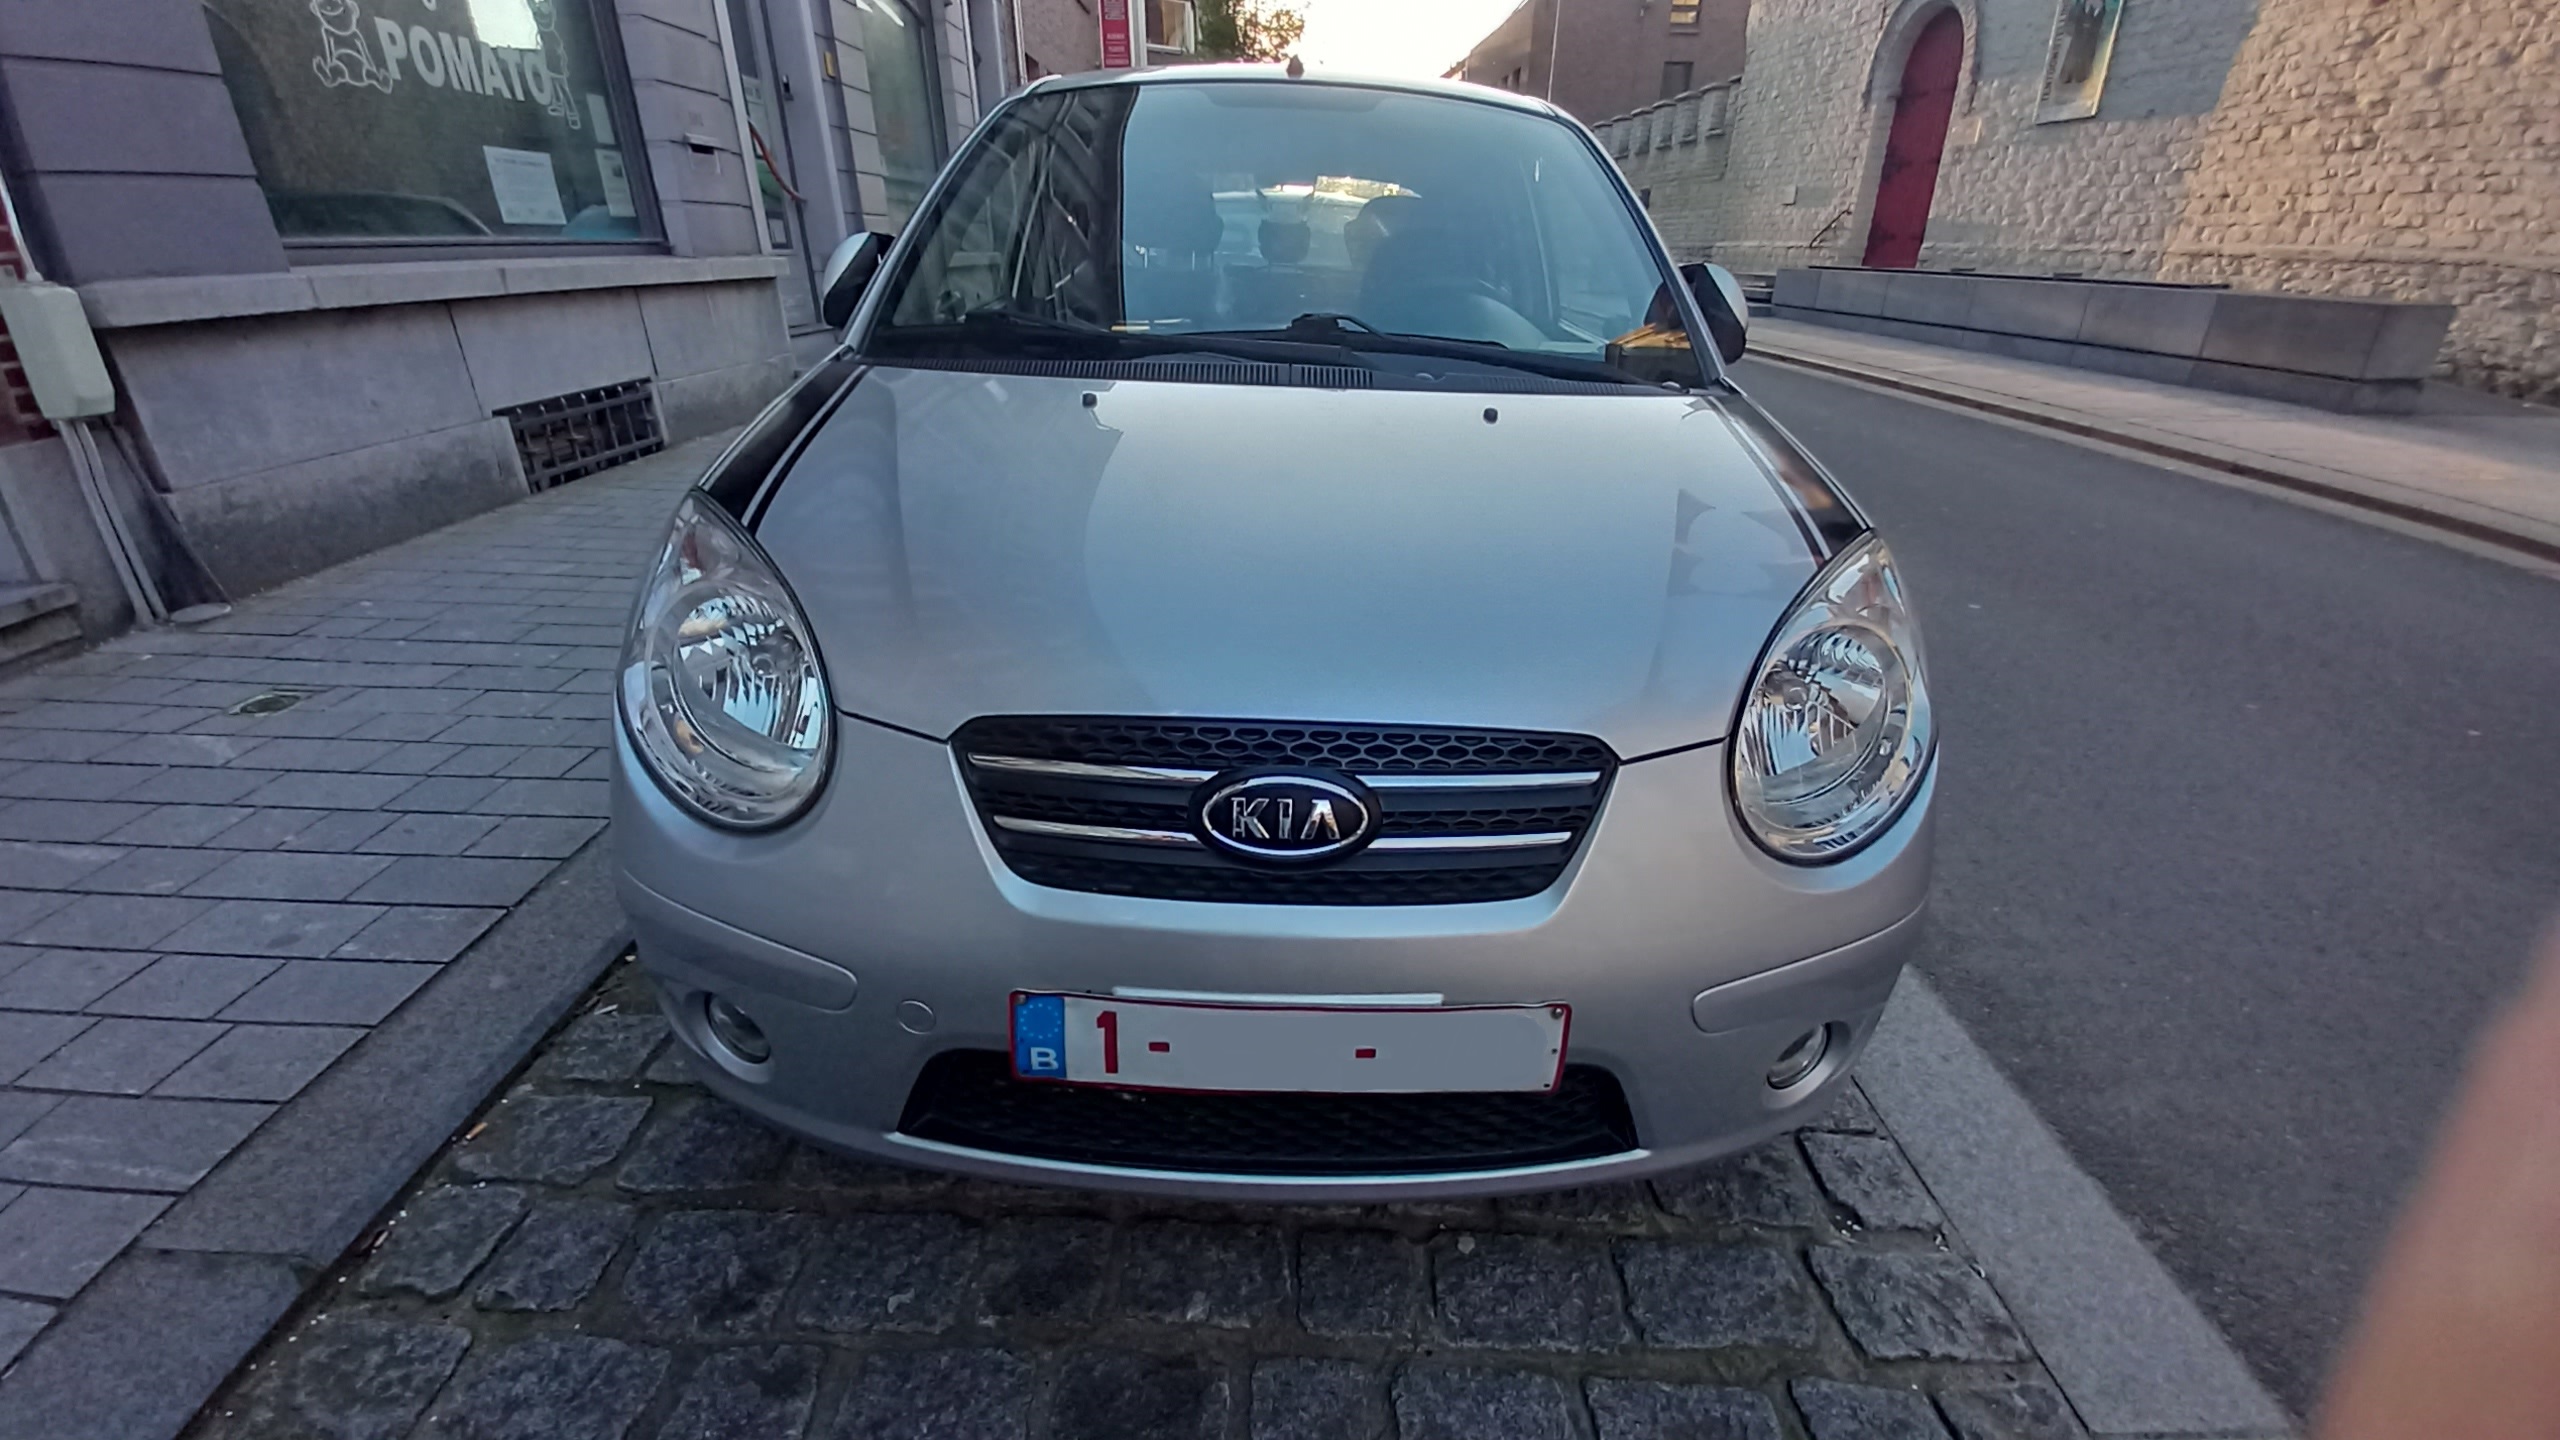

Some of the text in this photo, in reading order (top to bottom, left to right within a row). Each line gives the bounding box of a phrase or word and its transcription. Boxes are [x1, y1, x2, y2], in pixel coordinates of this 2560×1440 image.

[374, 16, 553, 105] POMATO
[1231, 797, 1340, 839] KIA
[1030, 1046, 1059, 1071] B
